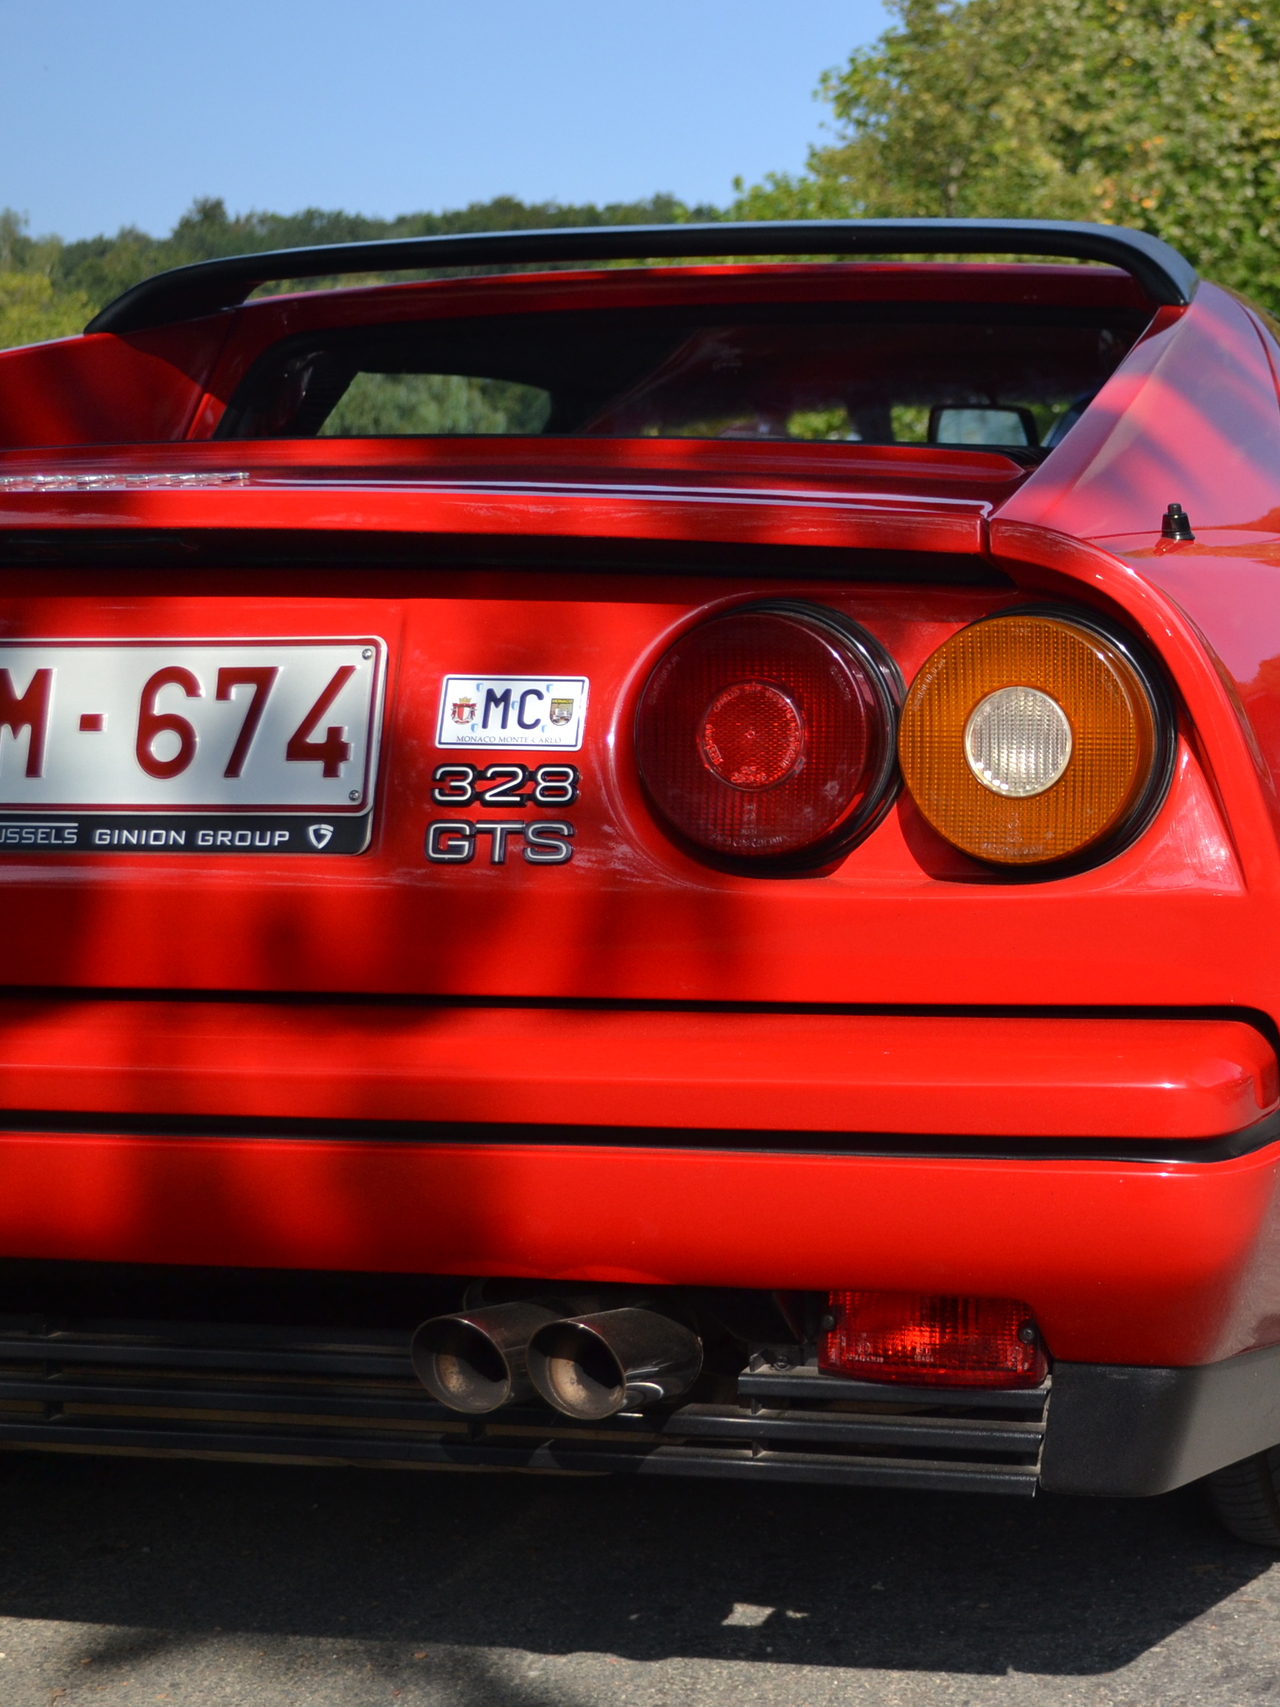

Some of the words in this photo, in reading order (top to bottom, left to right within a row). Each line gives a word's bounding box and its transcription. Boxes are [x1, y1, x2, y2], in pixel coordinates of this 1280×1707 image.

[481, 687, 545, 730] MC
[456, 735, 496, 743] MONACO
[498, 736, 562, 744] MONTE-CARLO
[431, 762, 580, 807] 328
[95, 829, 187, 846] GINION
[198, 830, 290, 847] GROUP
[424, 818, 574, 865] GTS
